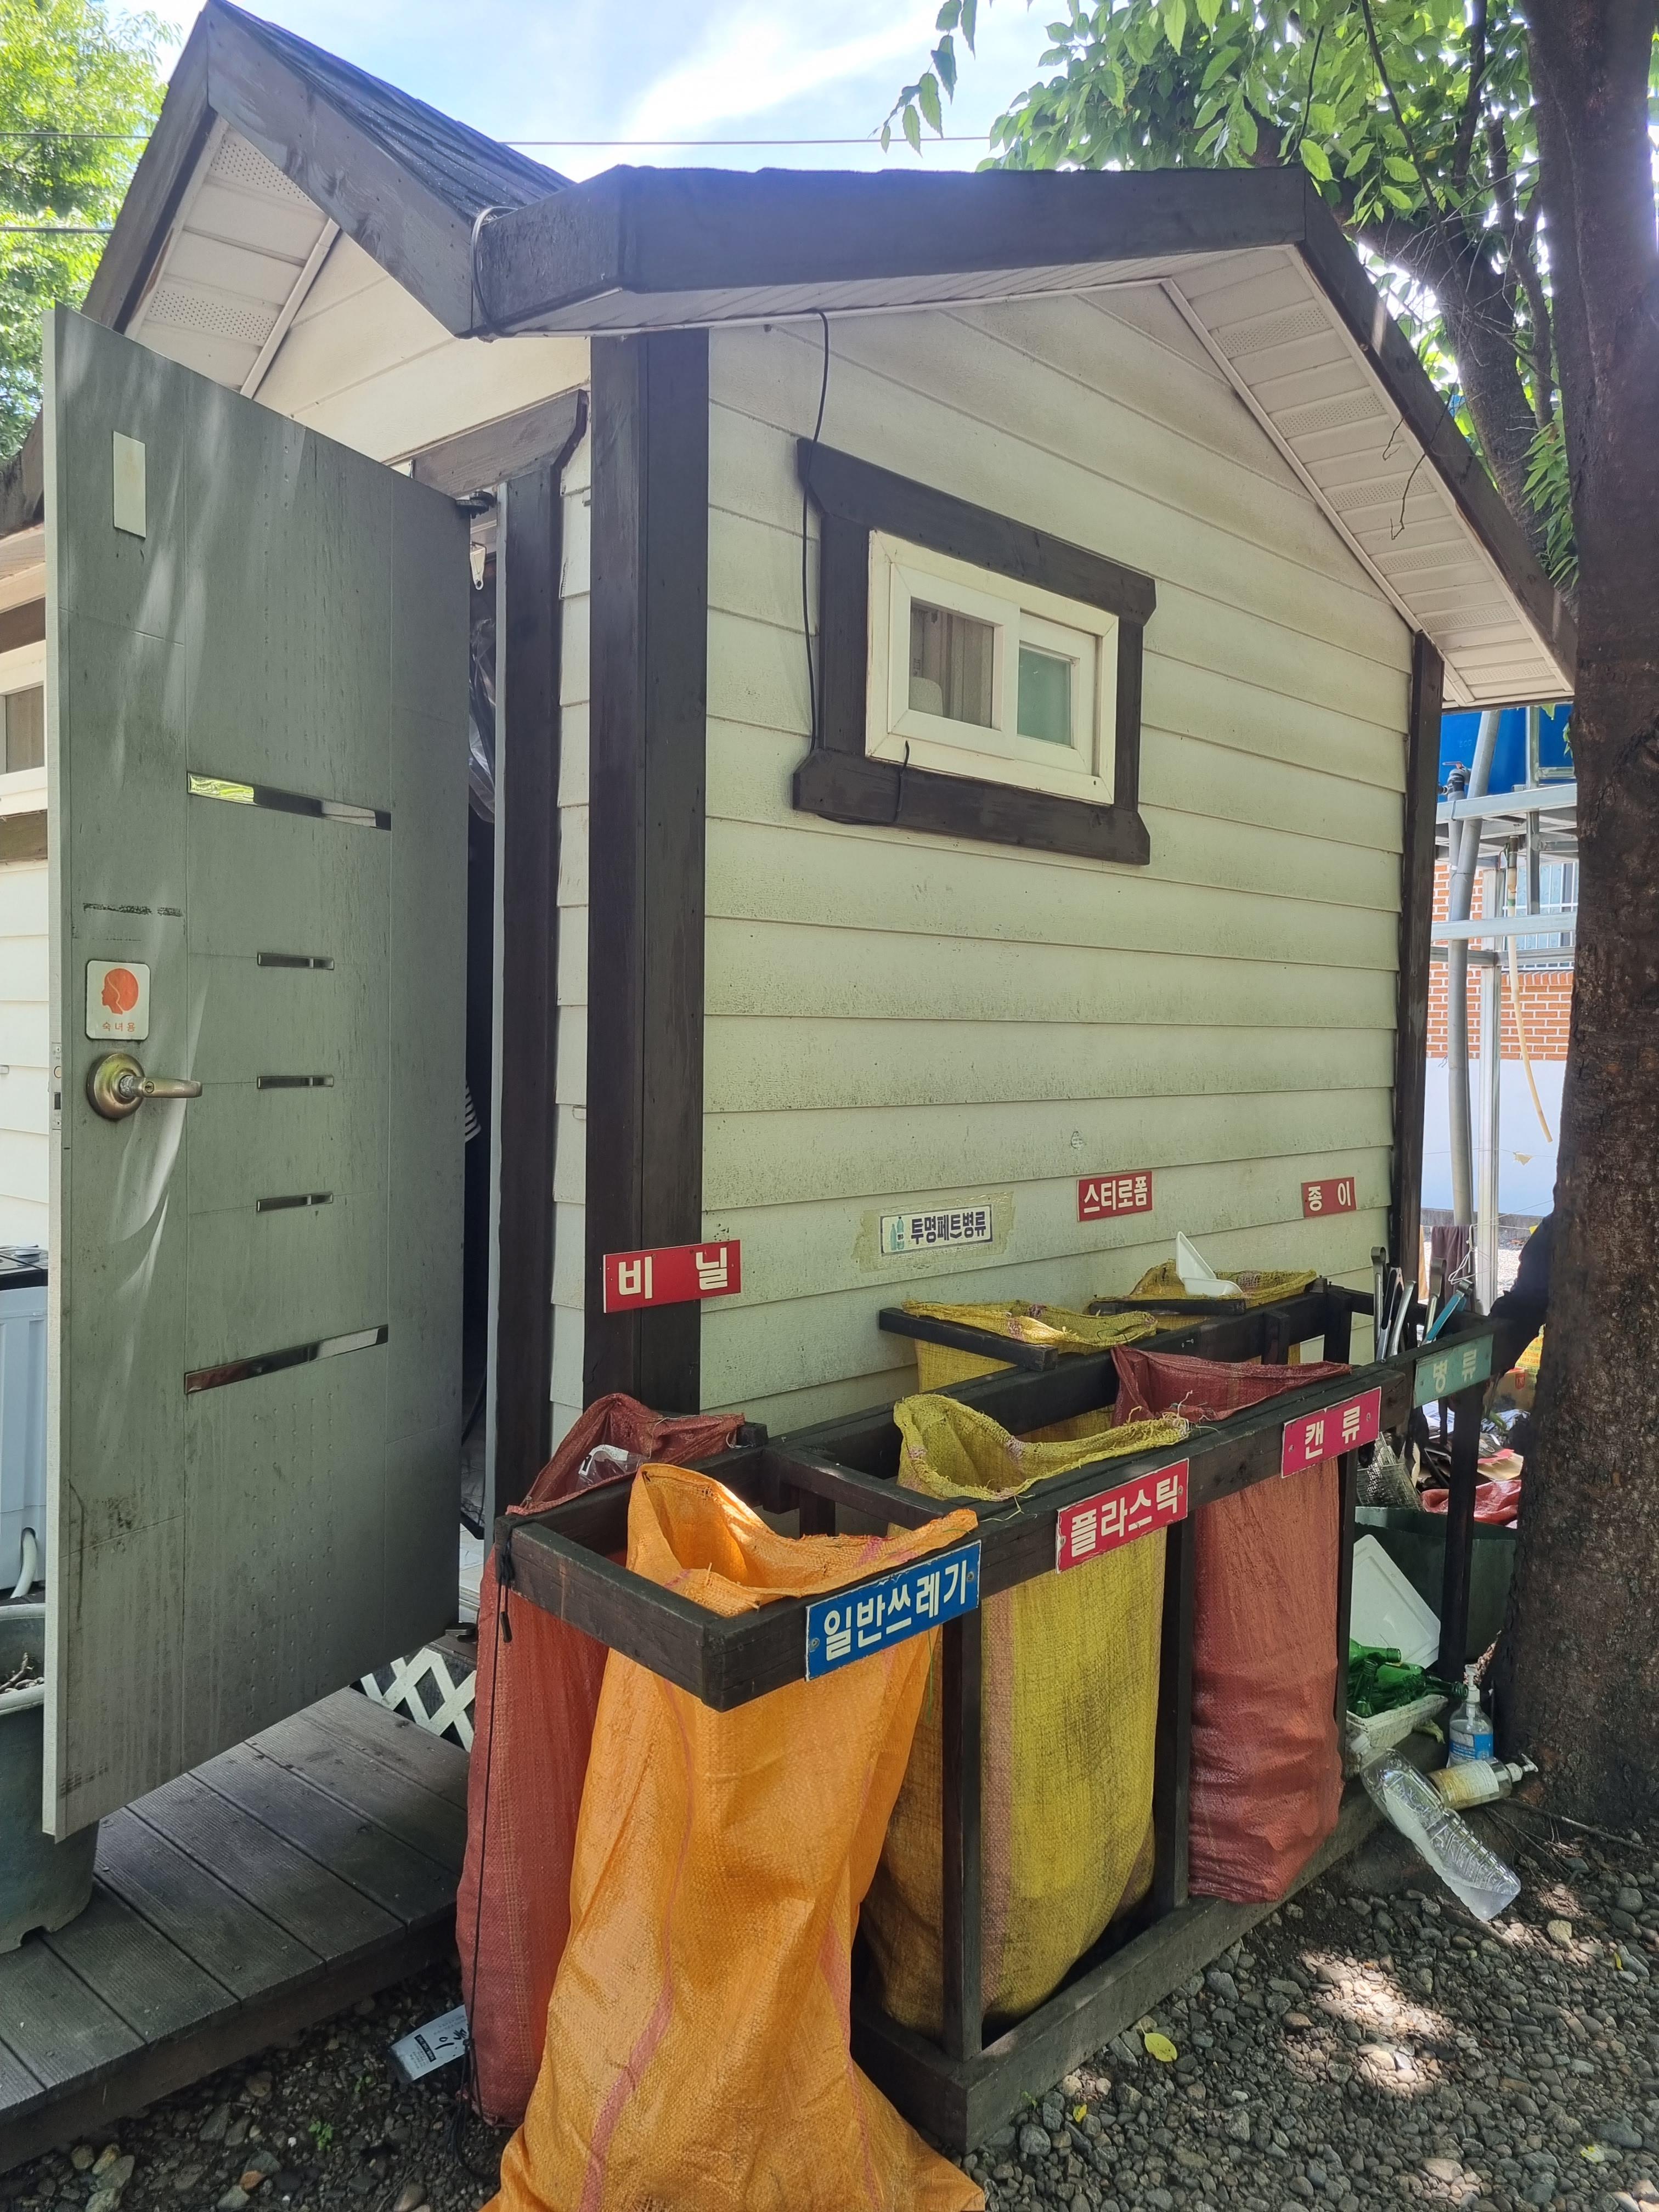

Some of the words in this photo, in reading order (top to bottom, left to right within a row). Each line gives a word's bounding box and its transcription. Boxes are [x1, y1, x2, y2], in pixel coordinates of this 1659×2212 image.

[102, 1022, 136, 1032] 숙녀용
[1084, 1176, 1148, 1214] 스티로폼
[911, 1211, 986, 1245] 투명페트병류
[1070, 1474, 1178, 1558] 플라스틱
[823, 1559, 967, 1662] 일반쓰레기
